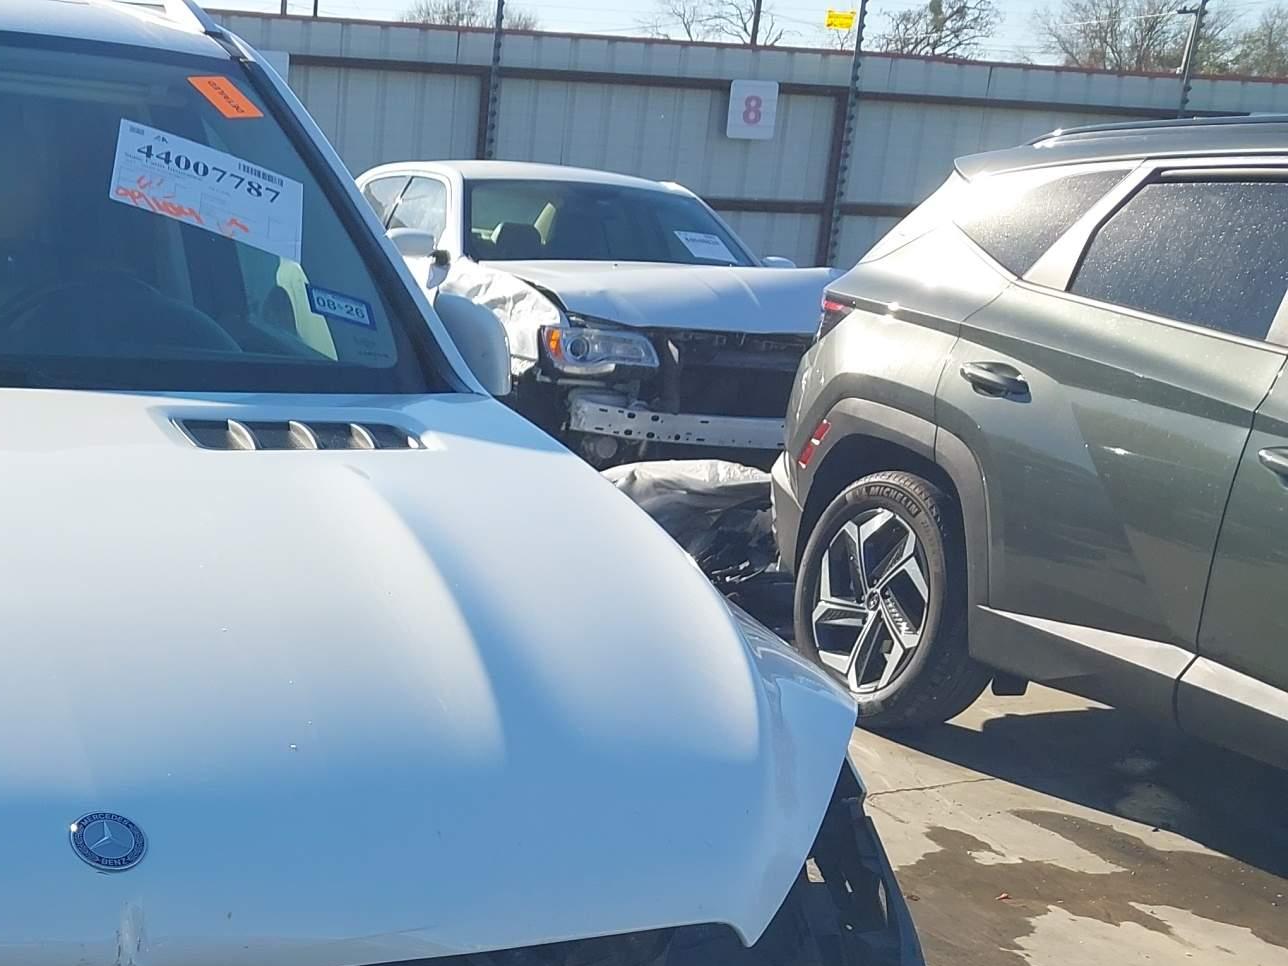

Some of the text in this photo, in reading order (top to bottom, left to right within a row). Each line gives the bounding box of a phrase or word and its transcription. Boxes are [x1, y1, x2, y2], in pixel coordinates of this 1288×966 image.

[742, 95, 763, 125] 8
[137, 144, 281, 203] 44007787
[869, 486, 919, 516] MICHELIN
